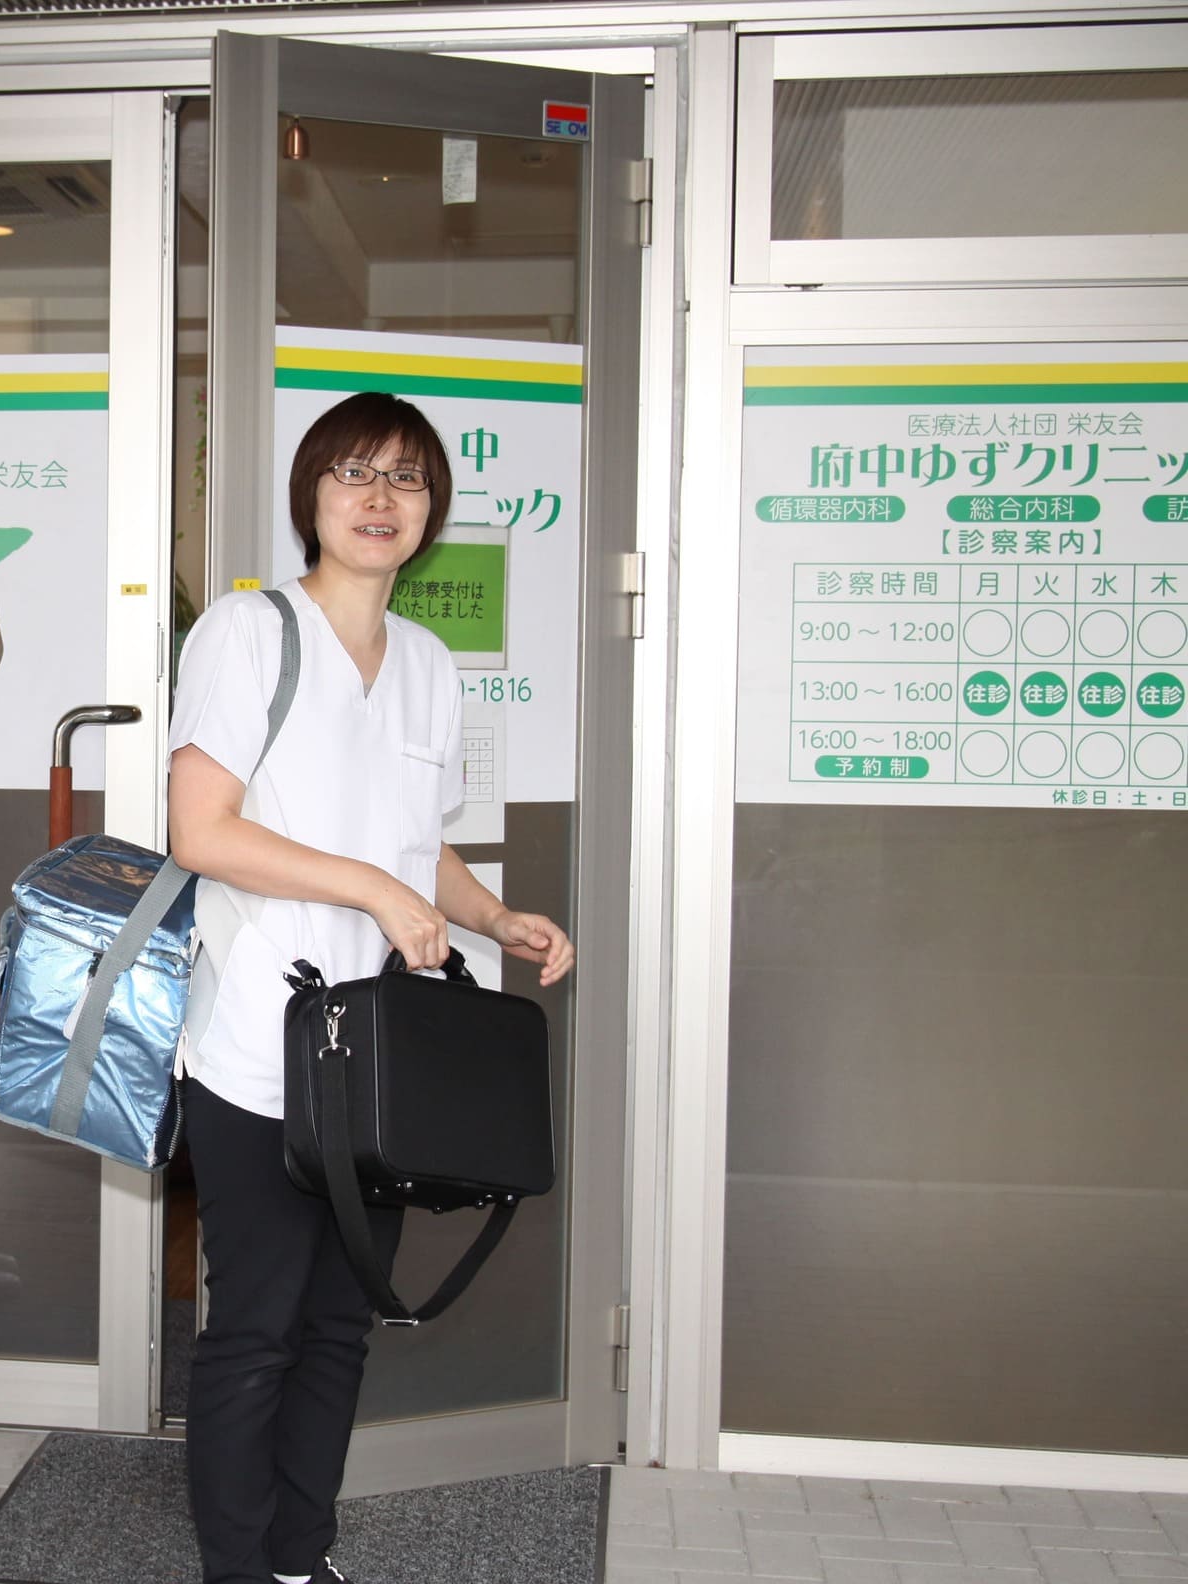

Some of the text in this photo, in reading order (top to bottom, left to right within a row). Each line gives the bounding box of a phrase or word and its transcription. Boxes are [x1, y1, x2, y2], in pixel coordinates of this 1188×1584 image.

[908, 411, 1143, 437] 医療法人社団 栄友会
[460, 427, 498, 472] 中
[807, 441, 1188, 489] 府中ゆずクリニッ
[453, 488, 561, 533] ニック
[768, 496, 891, 521] 循環器内科
[969, 496, 1075, 521] 総合内科
[391, 579, 484, 600] の診察受付は
[816, 571, 938, 597] 診察時間
[976, 572, 999, 597] 月
[1032, 571, 1060, 597] 火
[1091, 571, 1117, 597] 水
[1150, 572, 1177, 597] 木
[460, 677, 532, 702] -1816
[966, 683, 1008, 704] 往診
[1023, 684, 1065, 704] 往診
[1082, 684, 1124, 705] 往診
[1140, 685, 1182, 705] 往診
[835, 757, 910, 777] 予約制
